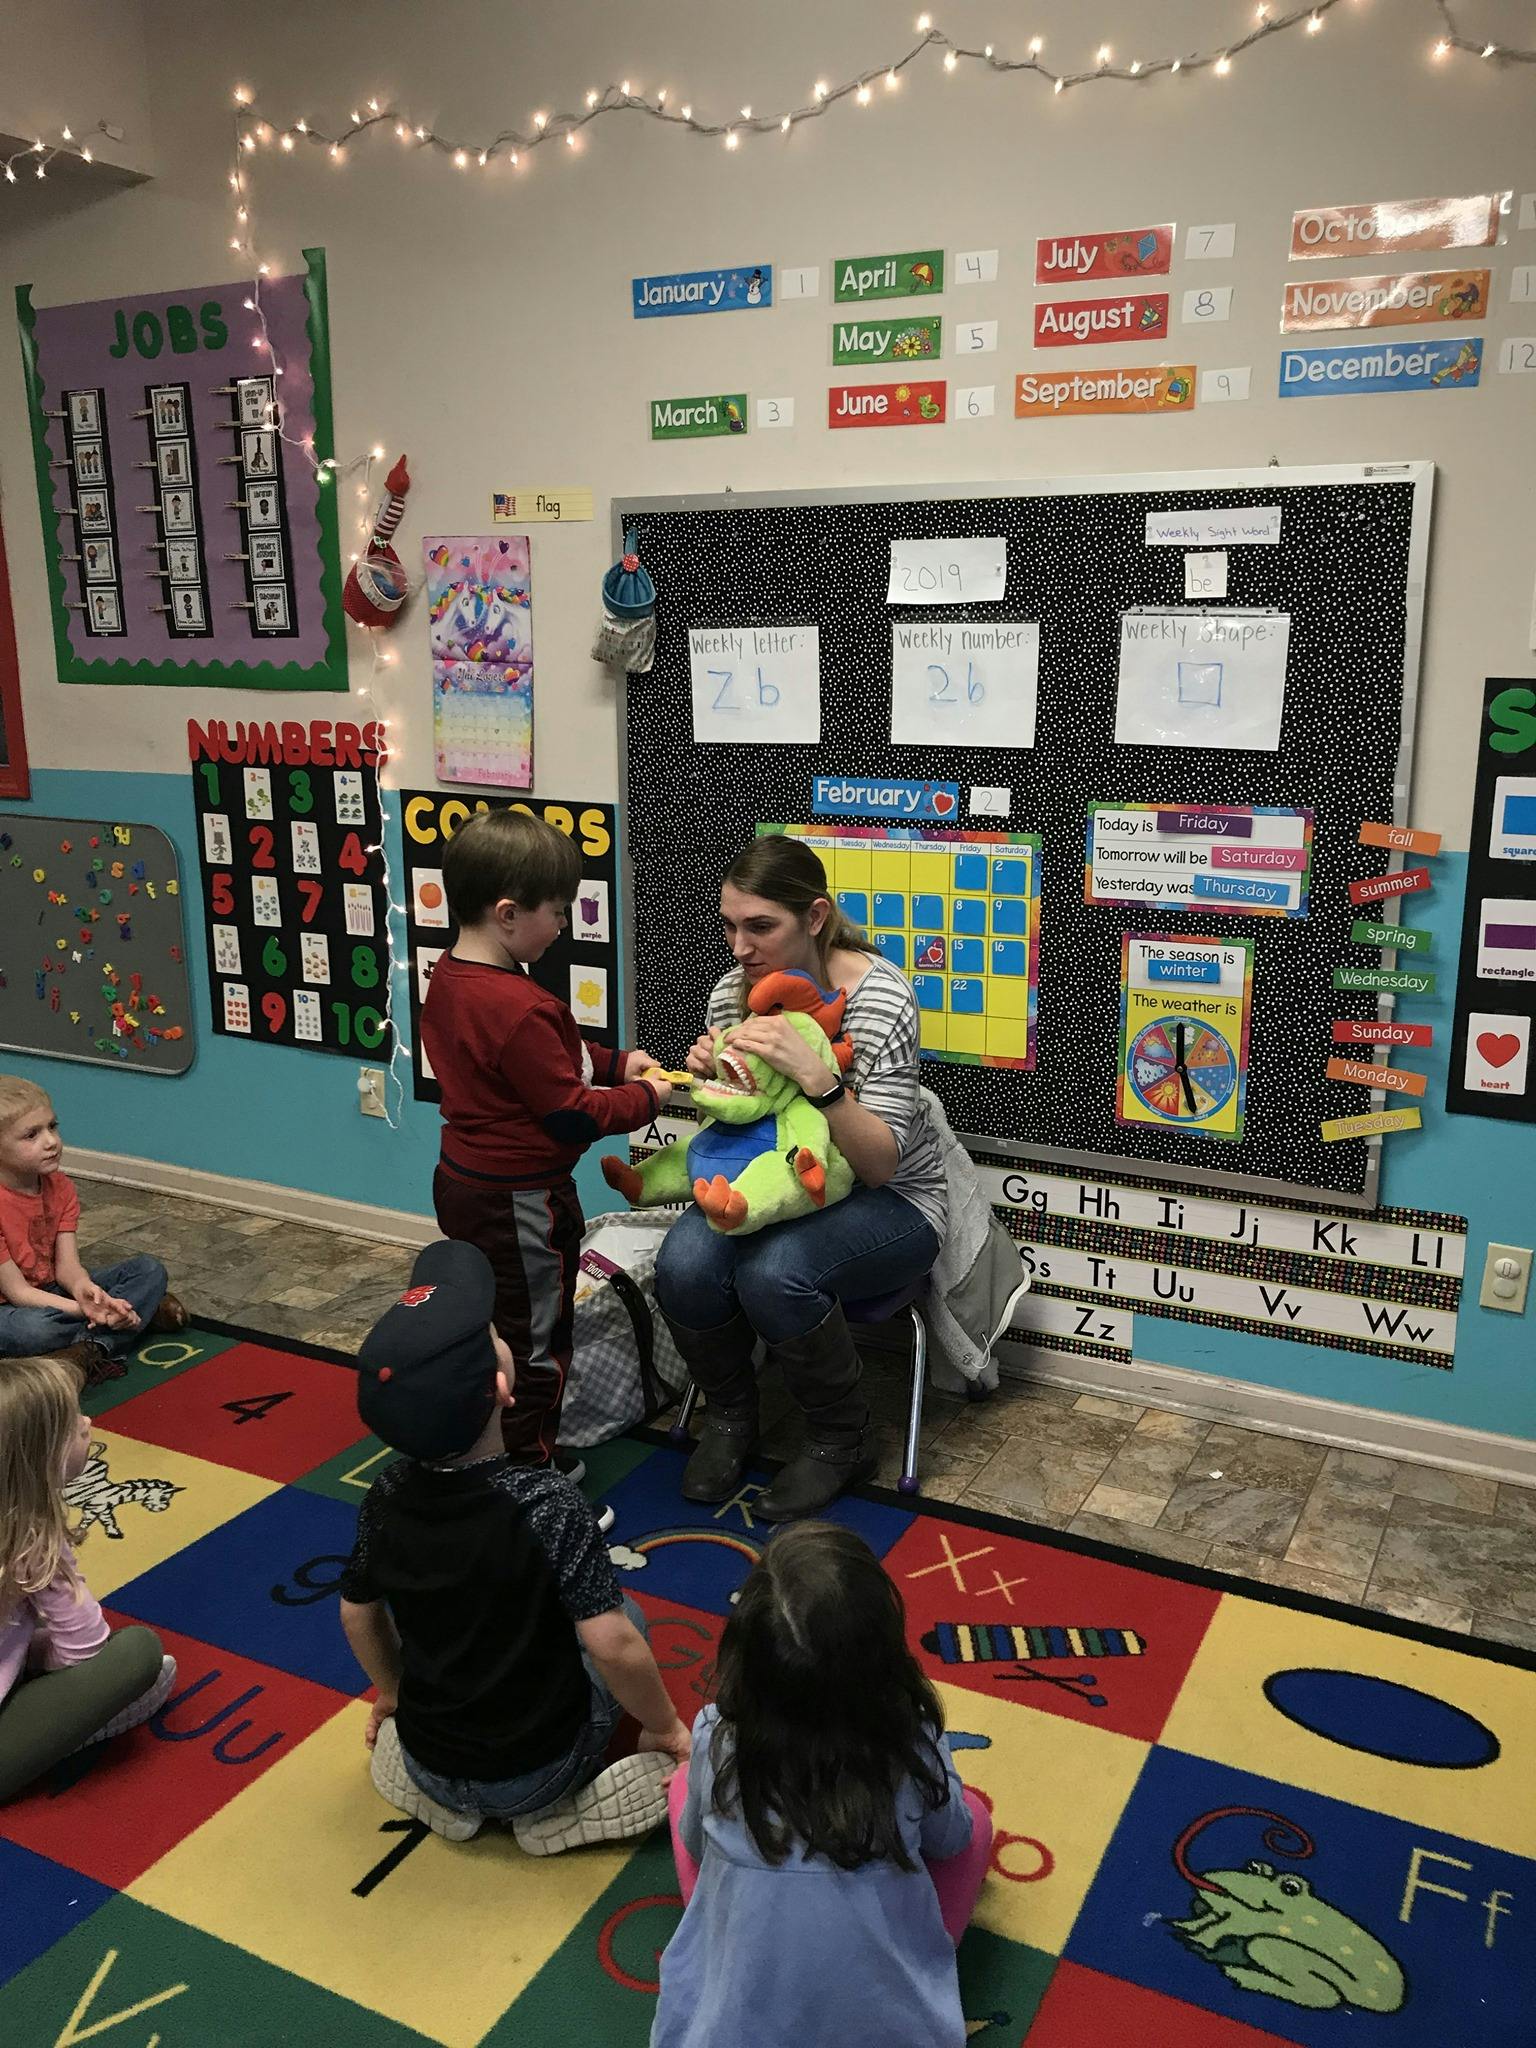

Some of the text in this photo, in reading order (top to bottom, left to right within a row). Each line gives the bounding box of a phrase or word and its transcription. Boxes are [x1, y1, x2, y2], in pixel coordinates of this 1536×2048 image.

[1300, 205, 1425, 244] Octo
[1198, 231, 1214, 253] 7
[966, 256, 982, 279] 4
[1044, 240, 1098, 273] July
[840, 262, 896, 296] April
[638, 279, 726, 307] January
[1195, 291, 1215, 316] 8
[1293, 281, 1441, 316] November
[109, 302, 229, 359] JOBS
[1039, 305, 1134, 340] August
[839, 326, 892, 357] May
[971, 328, 984, 350] 5
[1284, 349, 1440, 383] December
[1020, 372, 1162, 408] September
[1217, 377, 1230, 397] 9
[654, 401, 718, 429] March
[768, 402, 780, 422] 3
[836, 391, 888, 417] June
[968, 392, 980, 416] 6
[536, 495, 561, 519] flag
[1156, 525, 1270, 541] Weekly Sight Word
[902, 564, 962, 591] 2019
[1190, 568, 1212, 593] be
[692, 632, 806, 660] Weekly letter:
[899, 627, 1031, 655] Weekly number:
[1126, 619, 1186, 647] Weekly
[188, 719, 388, 767] NUMBERS
[200, 763, 220, 806] 1
[289, 770, 314, 813] 3
[817, 780, 921, 812] February
[981, 791, 999, 812] 2
[405, 796, 610, 856] CORS
[1098, 818, 1154, 835] Today is
[1179, 814, 1229, 834] Friday
[249, 826, 275, 869] 2
[805, 837, 1029, 855] Monday Tuesday Wednesday Thursday Friday Saturday
[1388, 830, 1414, 847] fall
[338, 832, 368, 876] 4
[996, 861, 1003, 871] 2
[1096, 847, 1208, 865] Tomorrow will be
[1221, 850, 1296, 868] Saturday
[212, 873, 234, 915] 5
[1096, 877, 1194, 895] Yesterday was
[1203, 878, 1277, 901] Thursday
[1360, 876, 1420, 898] summer
[297, 880, 324, 923] 7
[839, 893, 1002, 911] 5 6 7 8 9
[581, 932, 602, 940] purple
[877, 935, 1004, 952] 13 14 15 16
[1366, 927, 1416, 948] spring
[262, 935, 288, 977] 6
[351, 945, 379, 989] 8
[1139, 945, 1235, 964] The season is
[915, 976, 967, 991] 21 22
[1160, 964, 1208, 978] winter
[1339, 971, 1429, 991] Wednesday
[1482, 967, 1535, 978] rectangle
[261, 992, 286, 1034] 9
[1133, 994, 1237, 1016] The weather is
[332, 1002, 385, 1049] 10
[1352, 1025, 1414, 1044] Sunday
[1343, 1063, 1408, 1090] Monday
[1481, 1079, 1510, 1090] heart
[1335, 1112, 1405, 1135] Tuesday
[1002, 1175, 1443, 1268] Gg Hh Ii Jj Kk Ll
[1019, 1246, 1434, 1343] Ss Tt Uu Vv Ww
[1074, 1306, 1115, 1342] Zz
[220, 1392, 296, 1426] 4
[55, 1949, 190, 2048] V
